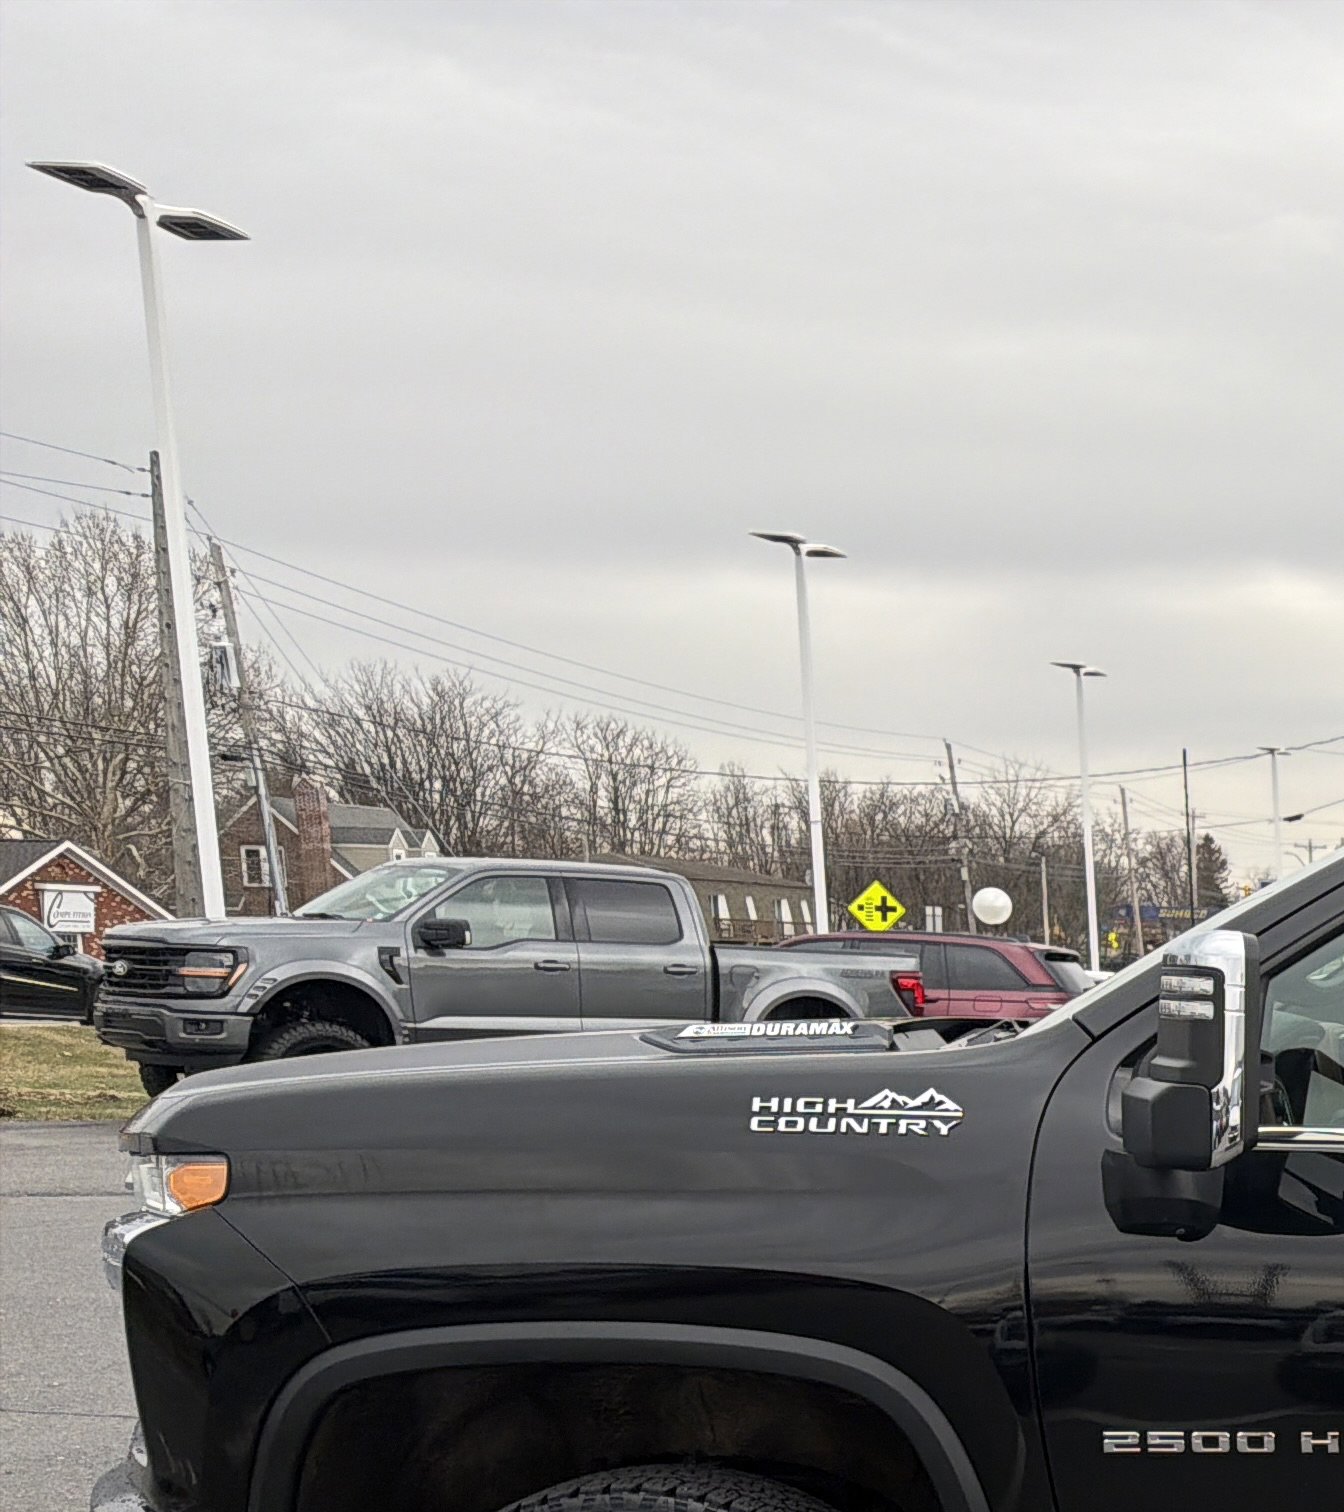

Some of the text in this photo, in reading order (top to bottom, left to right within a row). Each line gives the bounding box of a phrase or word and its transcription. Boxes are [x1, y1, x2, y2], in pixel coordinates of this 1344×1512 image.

[750, 1022, 857, 1036] DURAMAX
[751, 1097, 856, 1113] HIGH
[750, 1116, 962, 1135] COUNTRY
[1102, 1431, 1276, 1454] 2500
